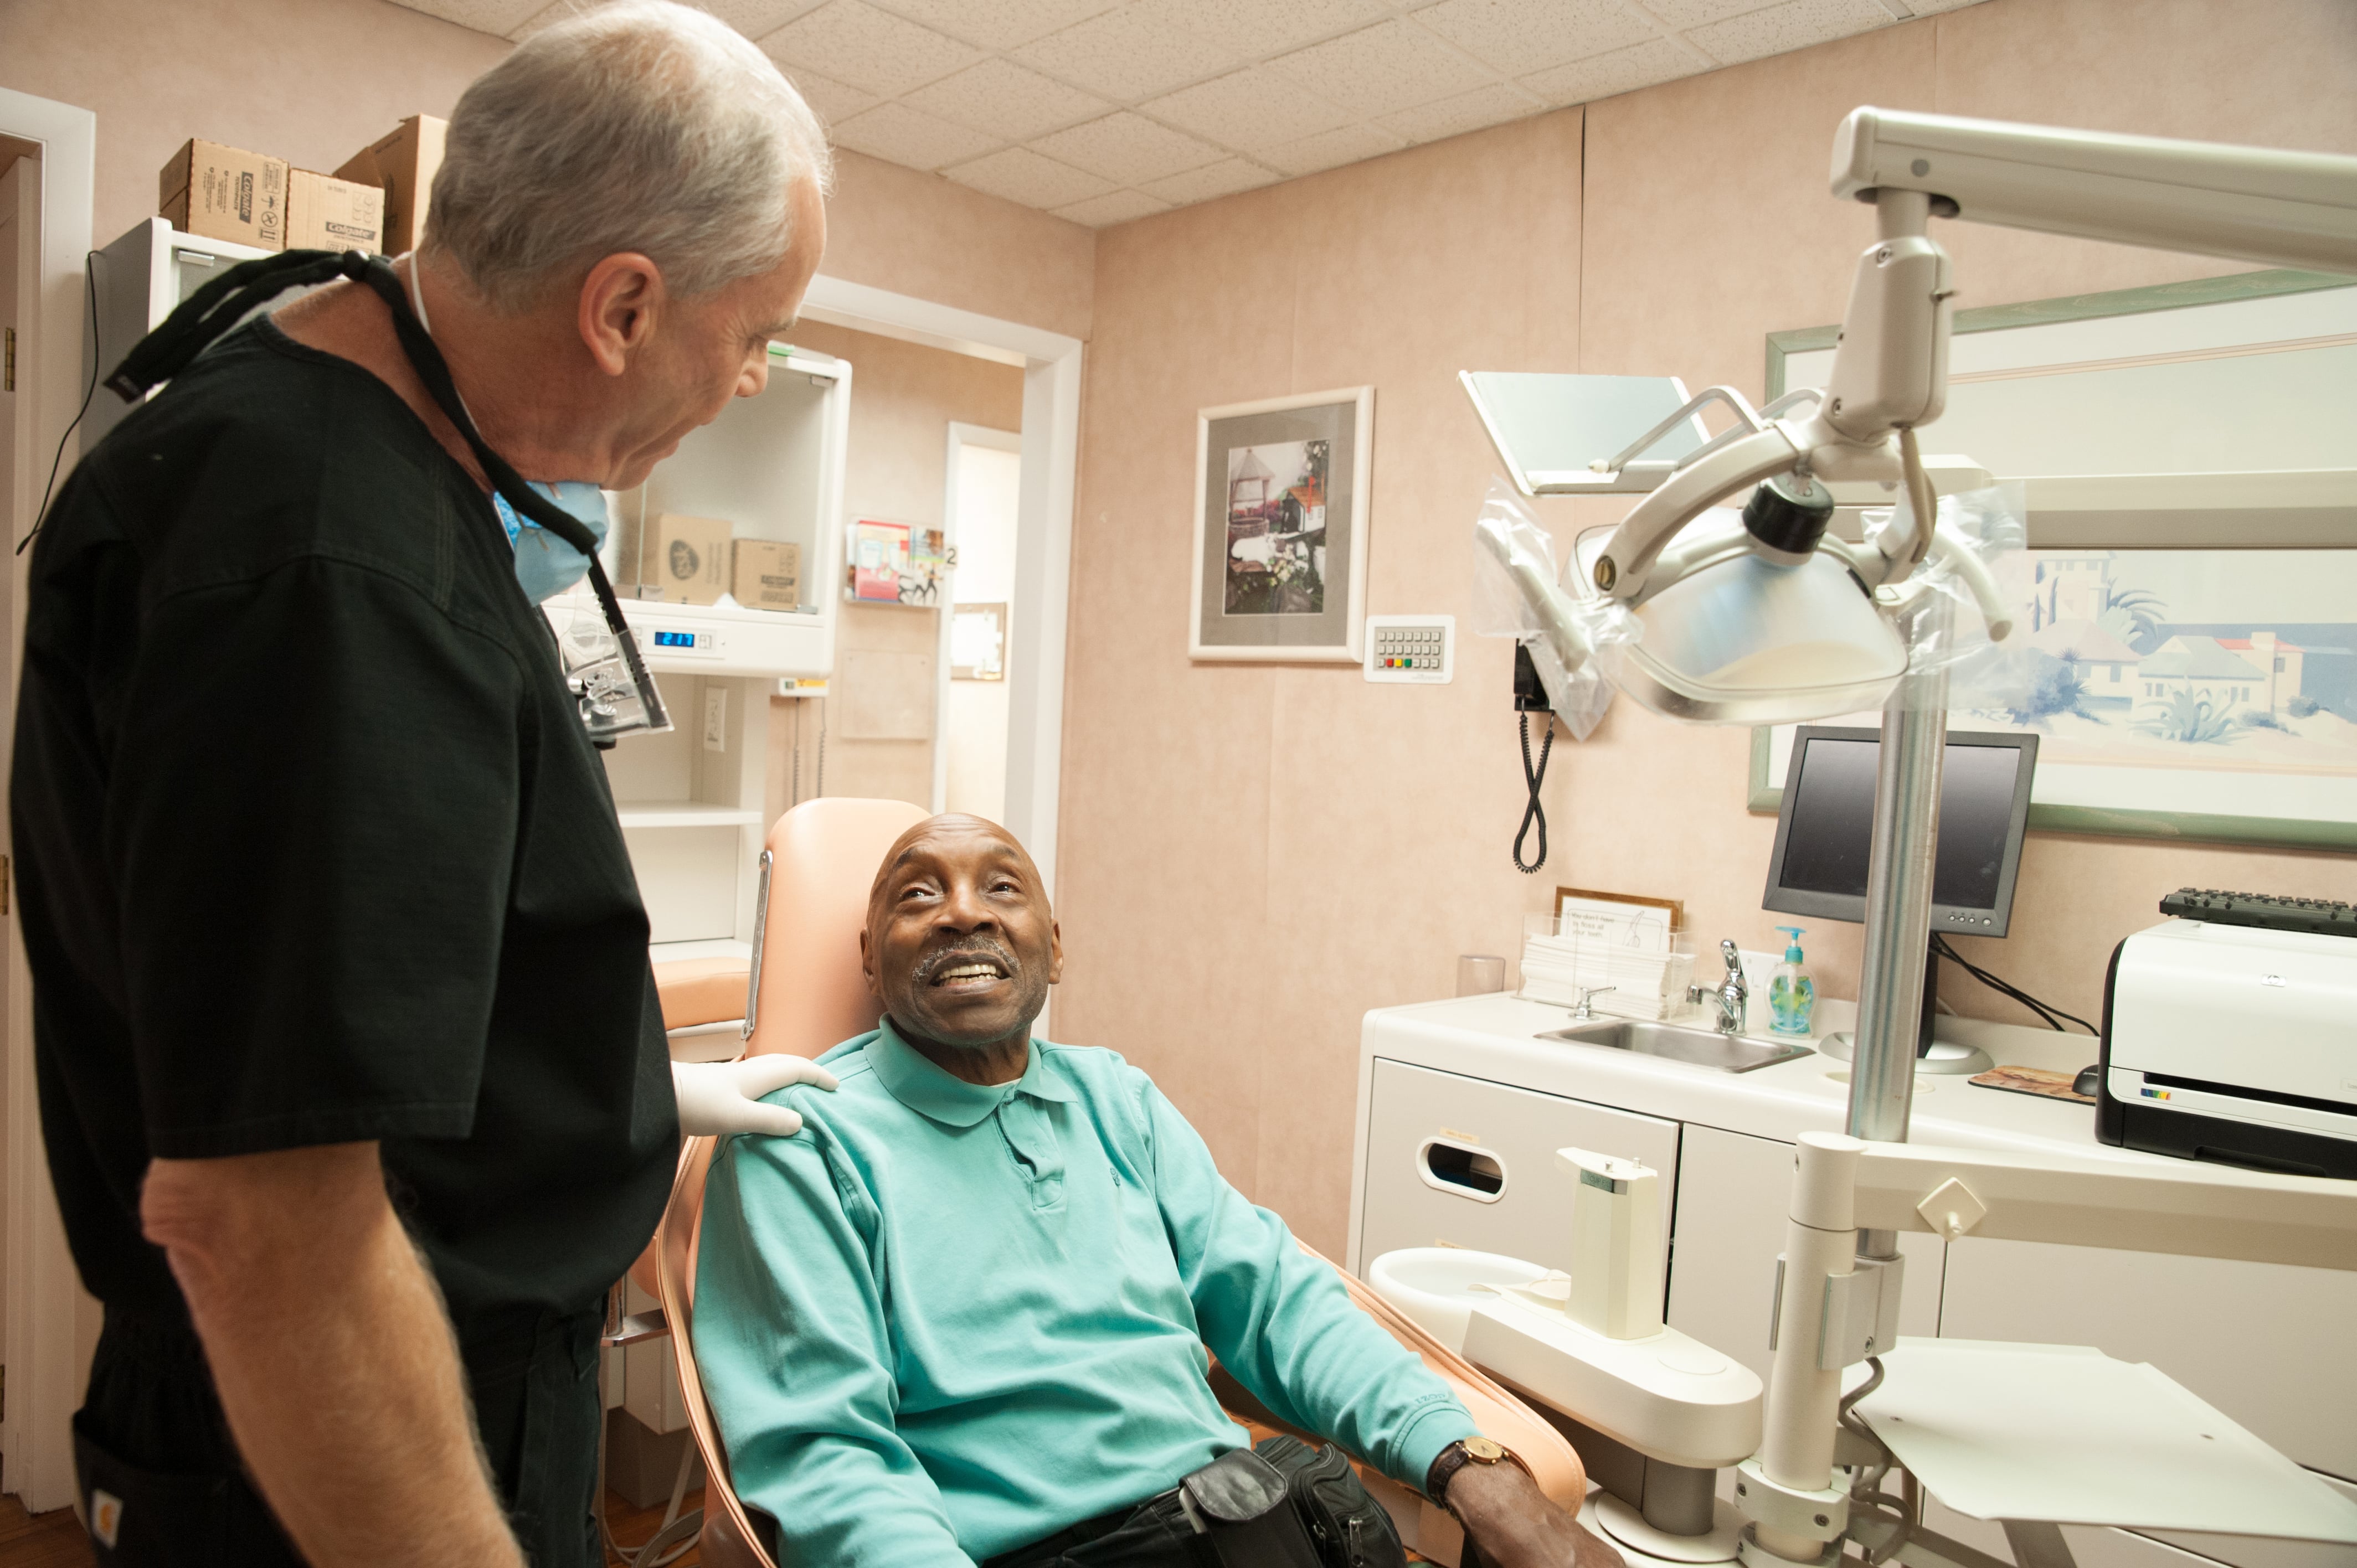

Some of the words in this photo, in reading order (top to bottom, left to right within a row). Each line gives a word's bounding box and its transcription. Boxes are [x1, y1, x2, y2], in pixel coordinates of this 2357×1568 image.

[242, 176, 253, 217] Colgate
[328, 223, 370, 238] Colgate
[947, 548, 956, 565] 2
[662, 632, 693, 646] 217
[1600, 915, 1614, 924] have
[1589, 1175, 1601, 1184] CUP
[1414, 1394, 1445, 1404] IZOD
